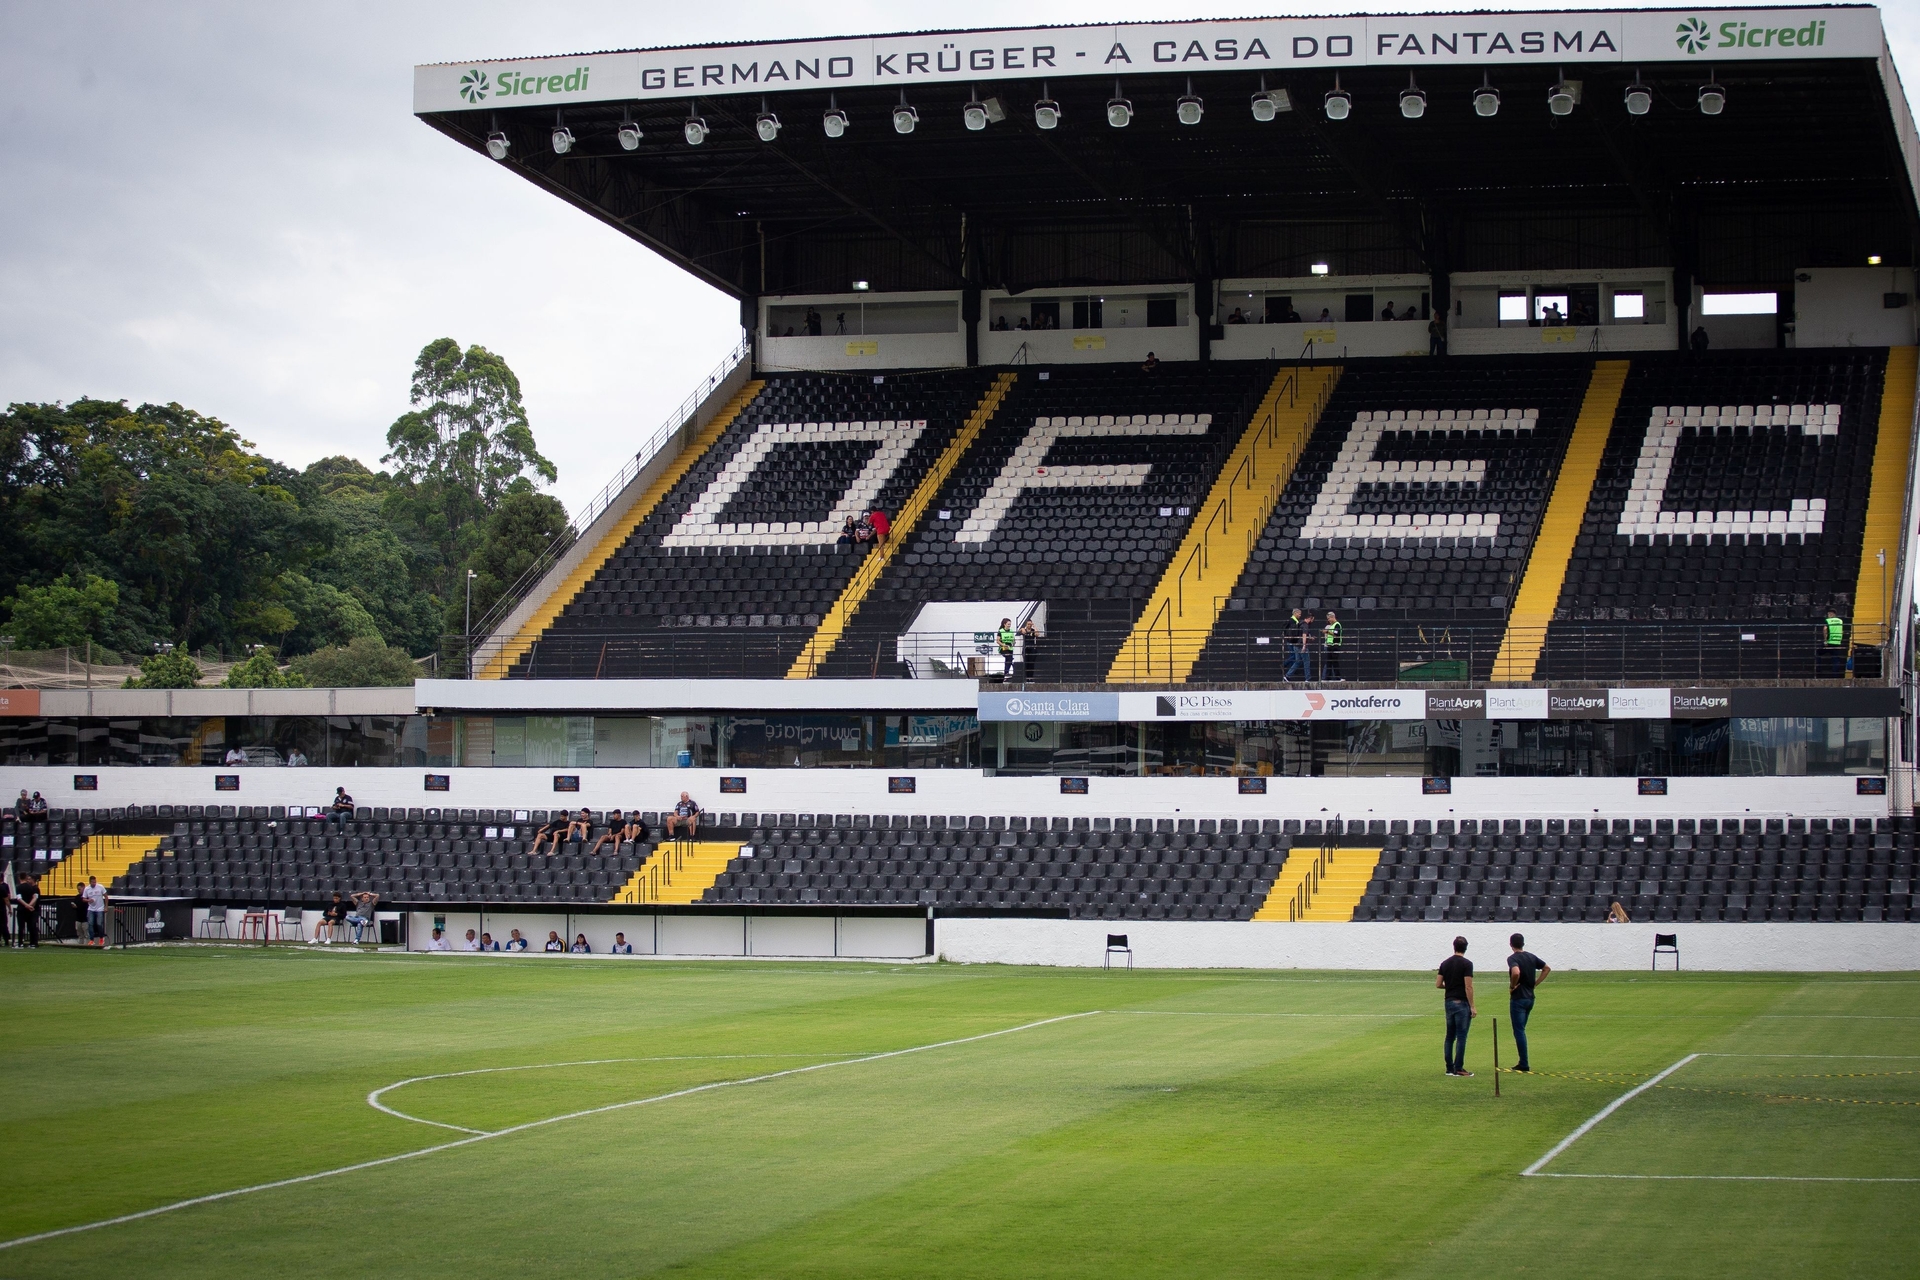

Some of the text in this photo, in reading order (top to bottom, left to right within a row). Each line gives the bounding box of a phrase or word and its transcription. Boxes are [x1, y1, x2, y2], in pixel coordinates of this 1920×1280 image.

[1717, 20, 1826, 49] Sicredi
[641, 55, 854, 90] GERMANO
[875, 43, 1057, 76] KRÜGER
[1104, 42, 1132, 65] A
[1152, 38, 1272, 63] CASA
[1292, 34, 1354, 59] DO
[1376, 29, 1617, 56] FANTASMA
[495, 66, 589, 98] Sicredi
[1023, 699, 1090, 711] Santa Clara
[1180, 696, 1233, 707] PG Pisos
[1331, 695, 1401, 711] pontaferro
[1429, 697, 1484, 709] PlantAgro
[1550, 696, 1606, 709] PlantAgro
[1673, 695, 1729, 708] PlantAgro
[899, 735, 938, 743] DAF
